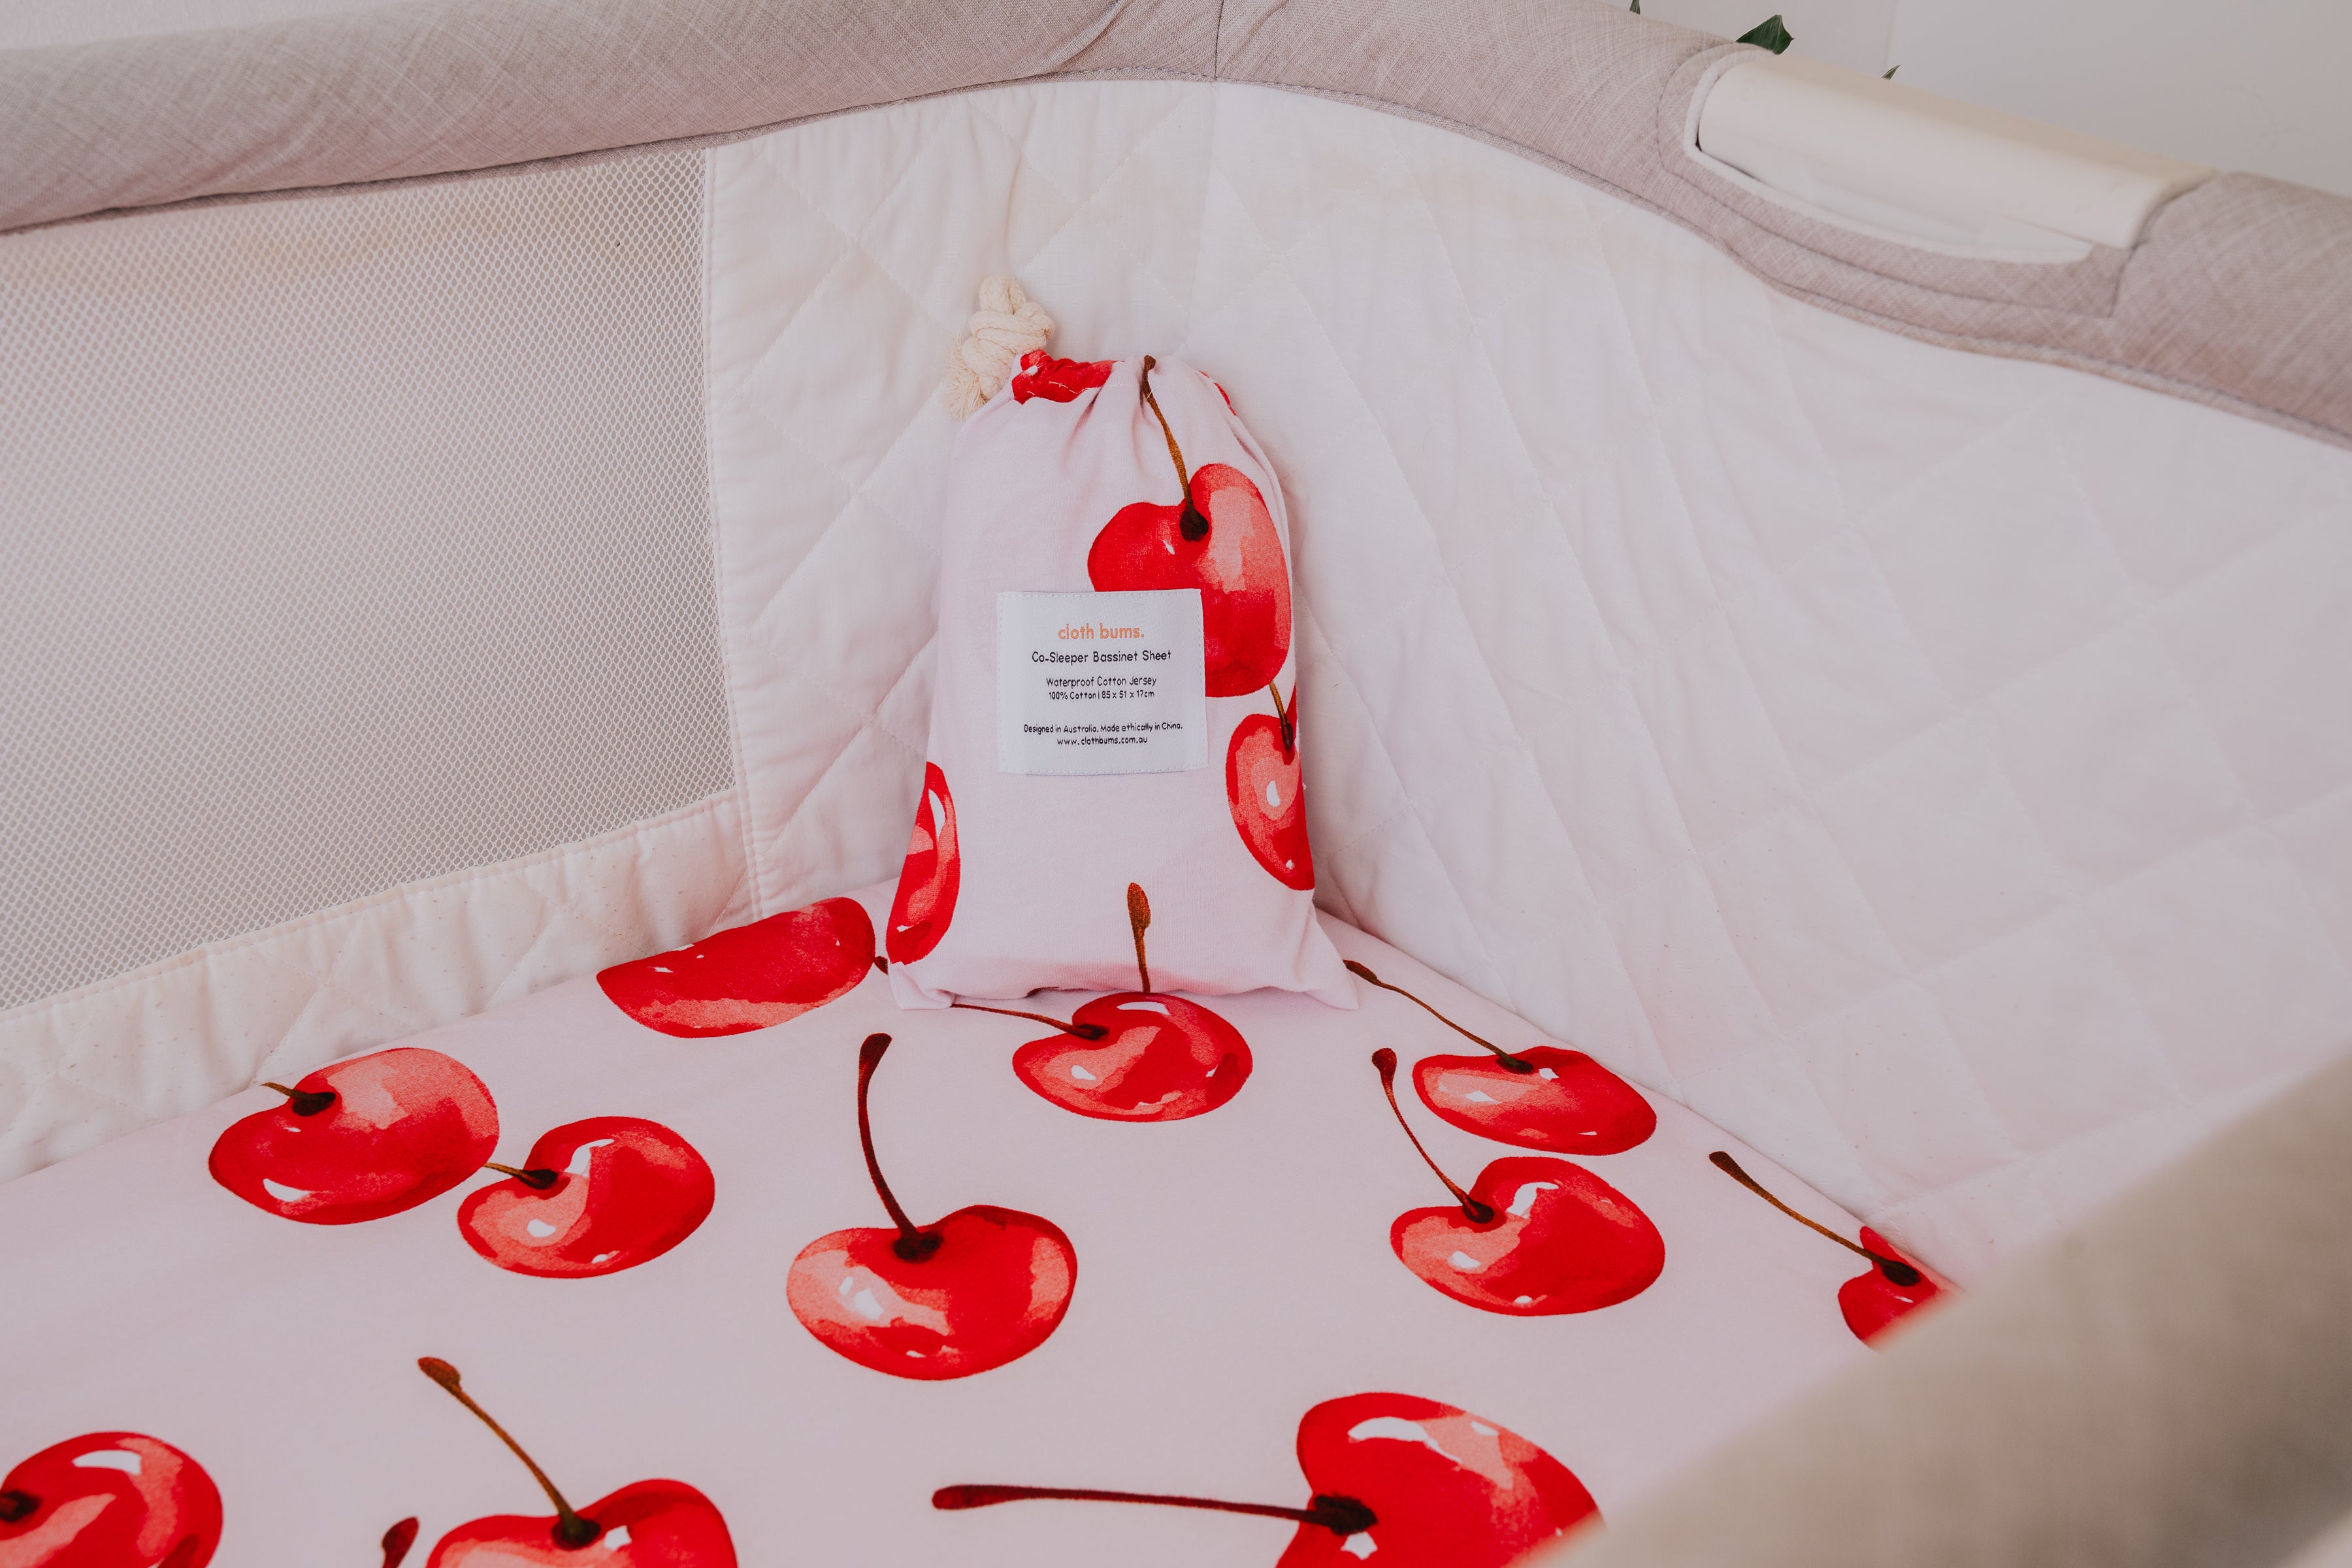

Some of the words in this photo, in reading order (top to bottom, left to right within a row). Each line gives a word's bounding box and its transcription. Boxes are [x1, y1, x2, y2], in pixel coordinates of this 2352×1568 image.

[1058, 623, 1094, 639] cloth
[1100, 623, 1144, 639] bums.
[1032, 651, 1088, 665] Co-Sleeper
[1093, 651, 1137, 662] Bassinet
[1143, 650, 1171, 661] Sheet
[1047, 677, 1094, 689] Waterproof
[1098, 676, 1126, 686] Cotton
[1130, 676, 1156, 687] Jersey
[1049, 691, 1068, 700] 100%
[1102, 691, 1110, 699] 85
[1024, 724, 1053, 735] Designed
[1056, 725, 1061, 733] in
[1064, 725, 1098, 733] Australia.
[1101, 723, 1119, 732] Made
[1122, 723, 1152, 732] ethically
[1162, 721, 1183, 730] China.
[1057, 736, 1147, 745] www.clothbums.com.au
